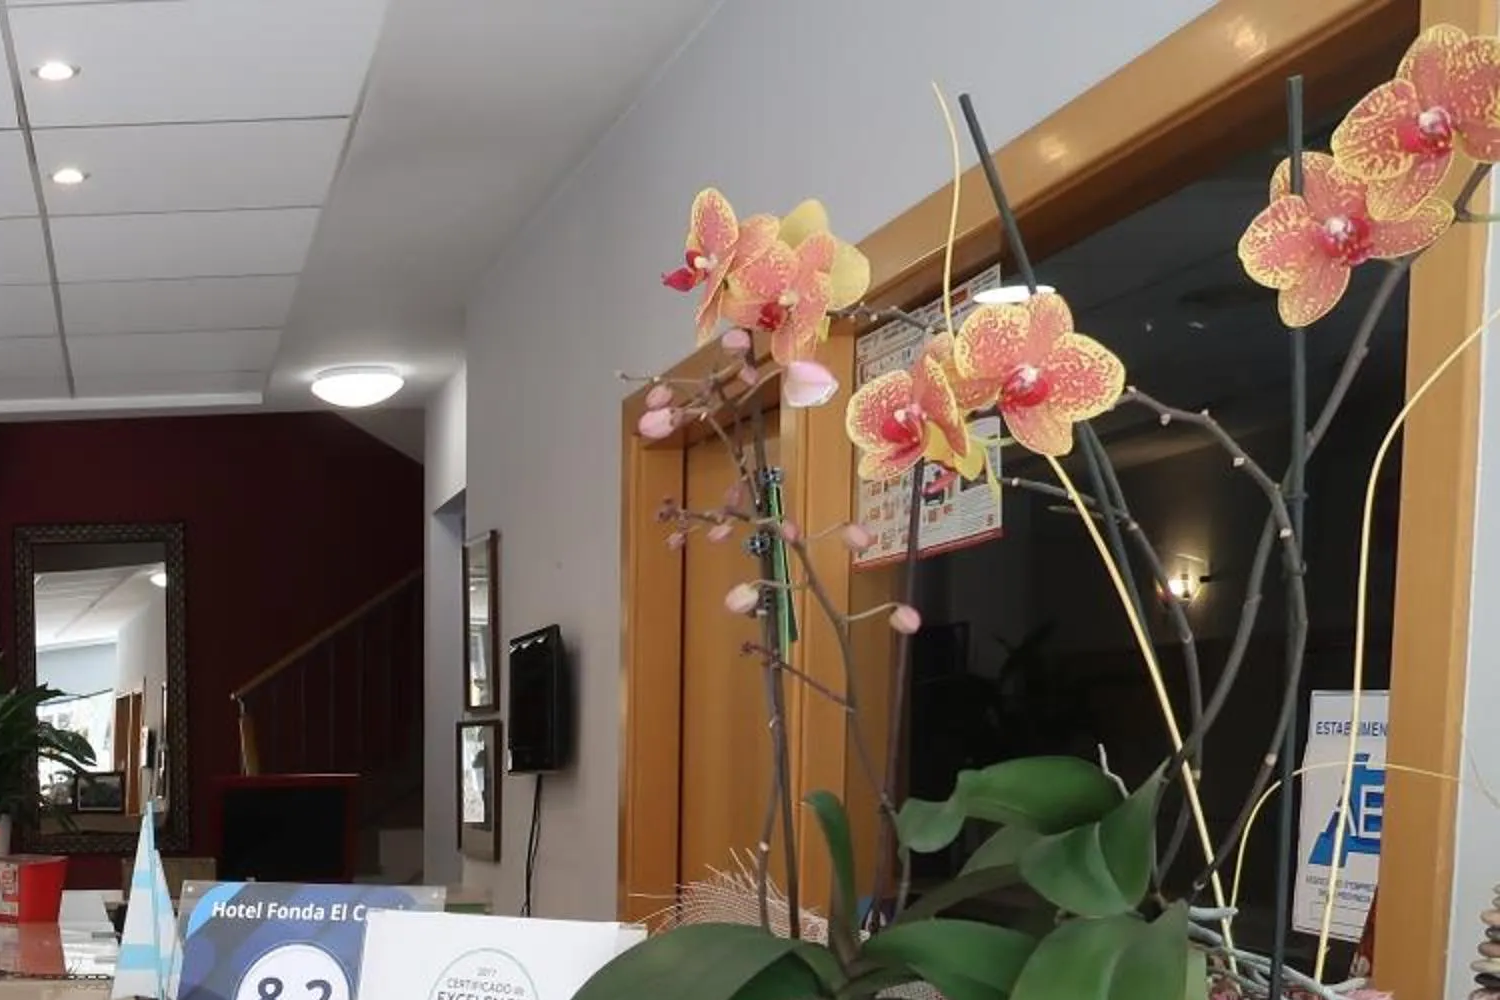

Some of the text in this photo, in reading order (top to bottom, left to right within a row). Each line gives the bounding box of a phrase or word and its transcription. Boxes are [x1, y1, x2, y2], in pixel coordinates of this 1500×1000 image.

[1315, 721, 1387, 737] ESTABMEN
[211, 901, 263, 918] Hotel
[267, 902, 325, 921] Fonda
[330, 903, 348, 921] El
